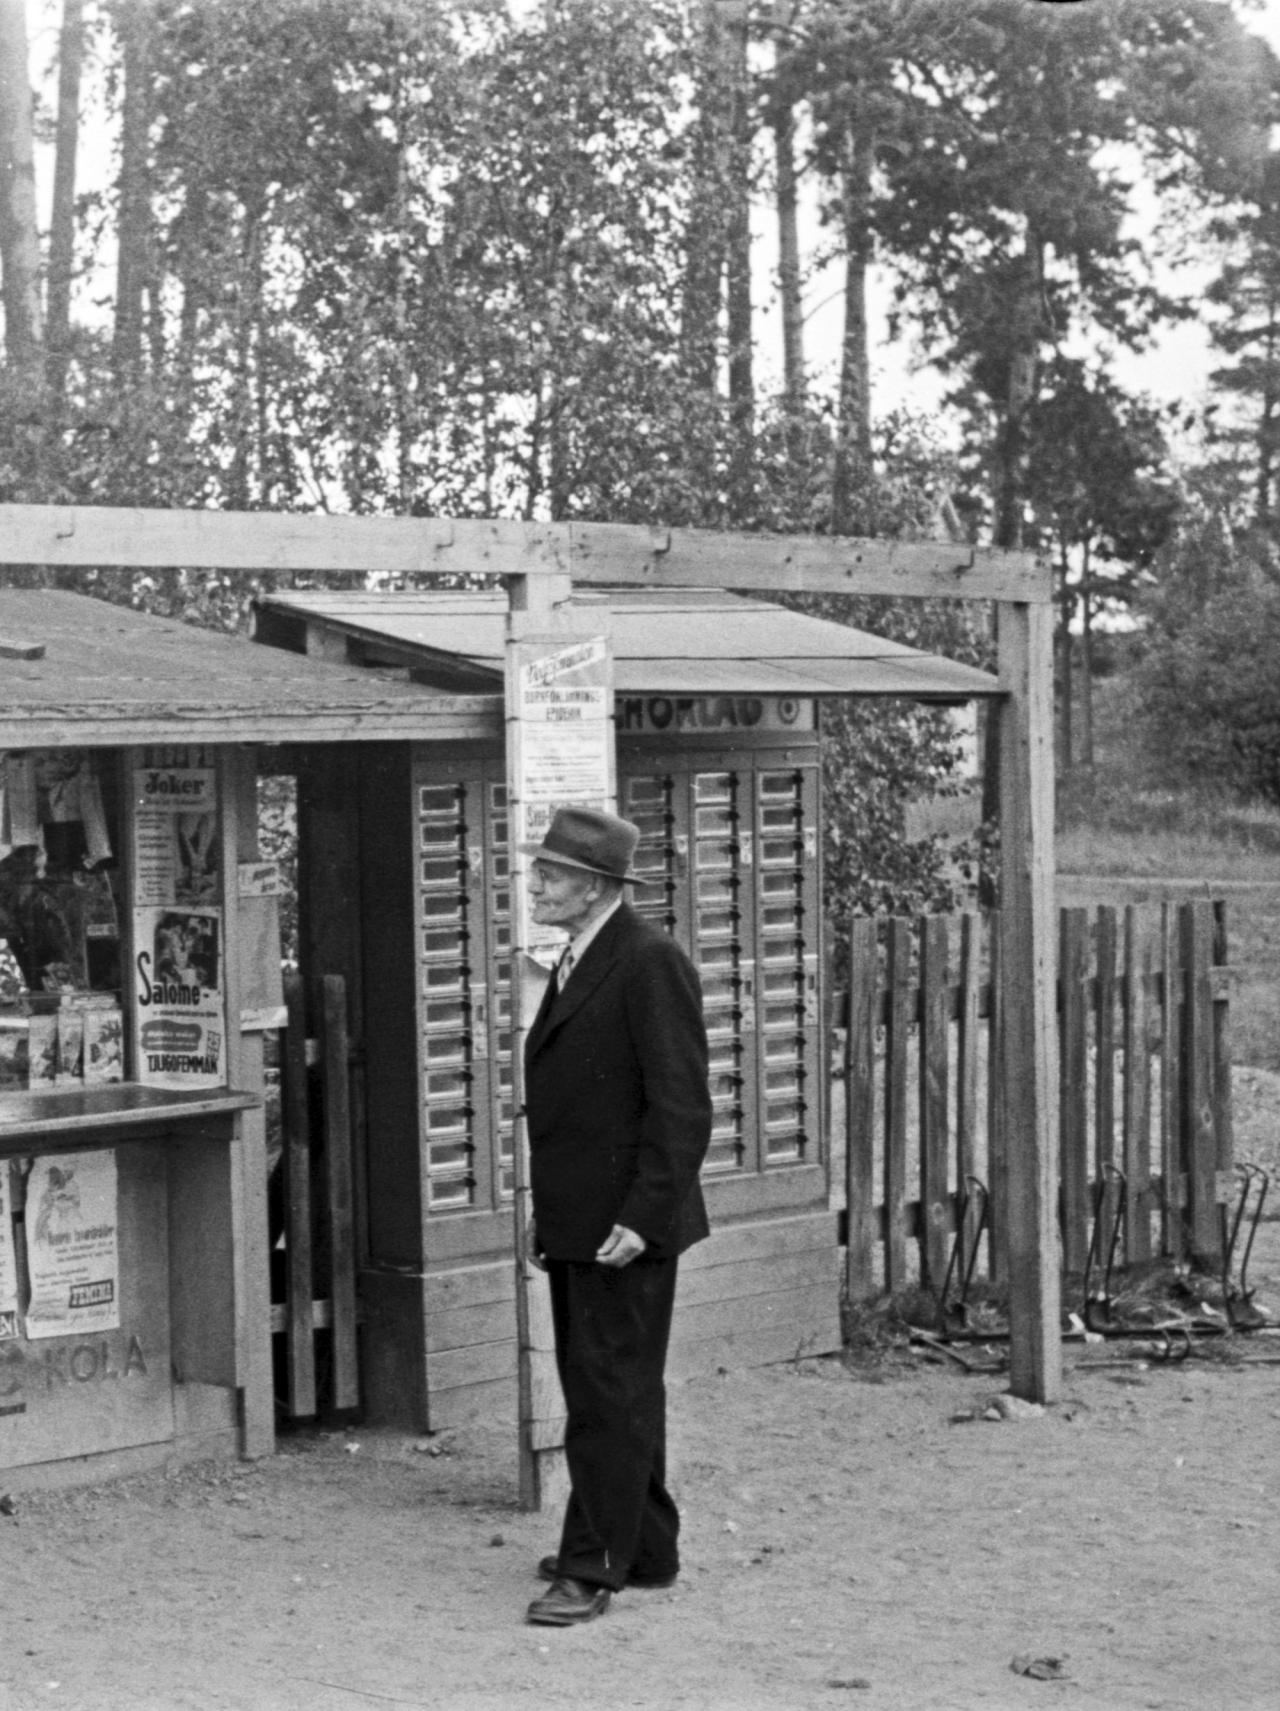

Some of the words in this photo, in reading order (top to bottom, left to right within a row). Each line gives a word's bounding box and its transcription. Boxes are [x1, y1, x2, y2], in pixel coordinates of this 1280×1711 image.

[145, 772, 204, 794] Joker
[136, 951, 201, 1006] Salome
[45, 1335, 148, 1392] KOLA
